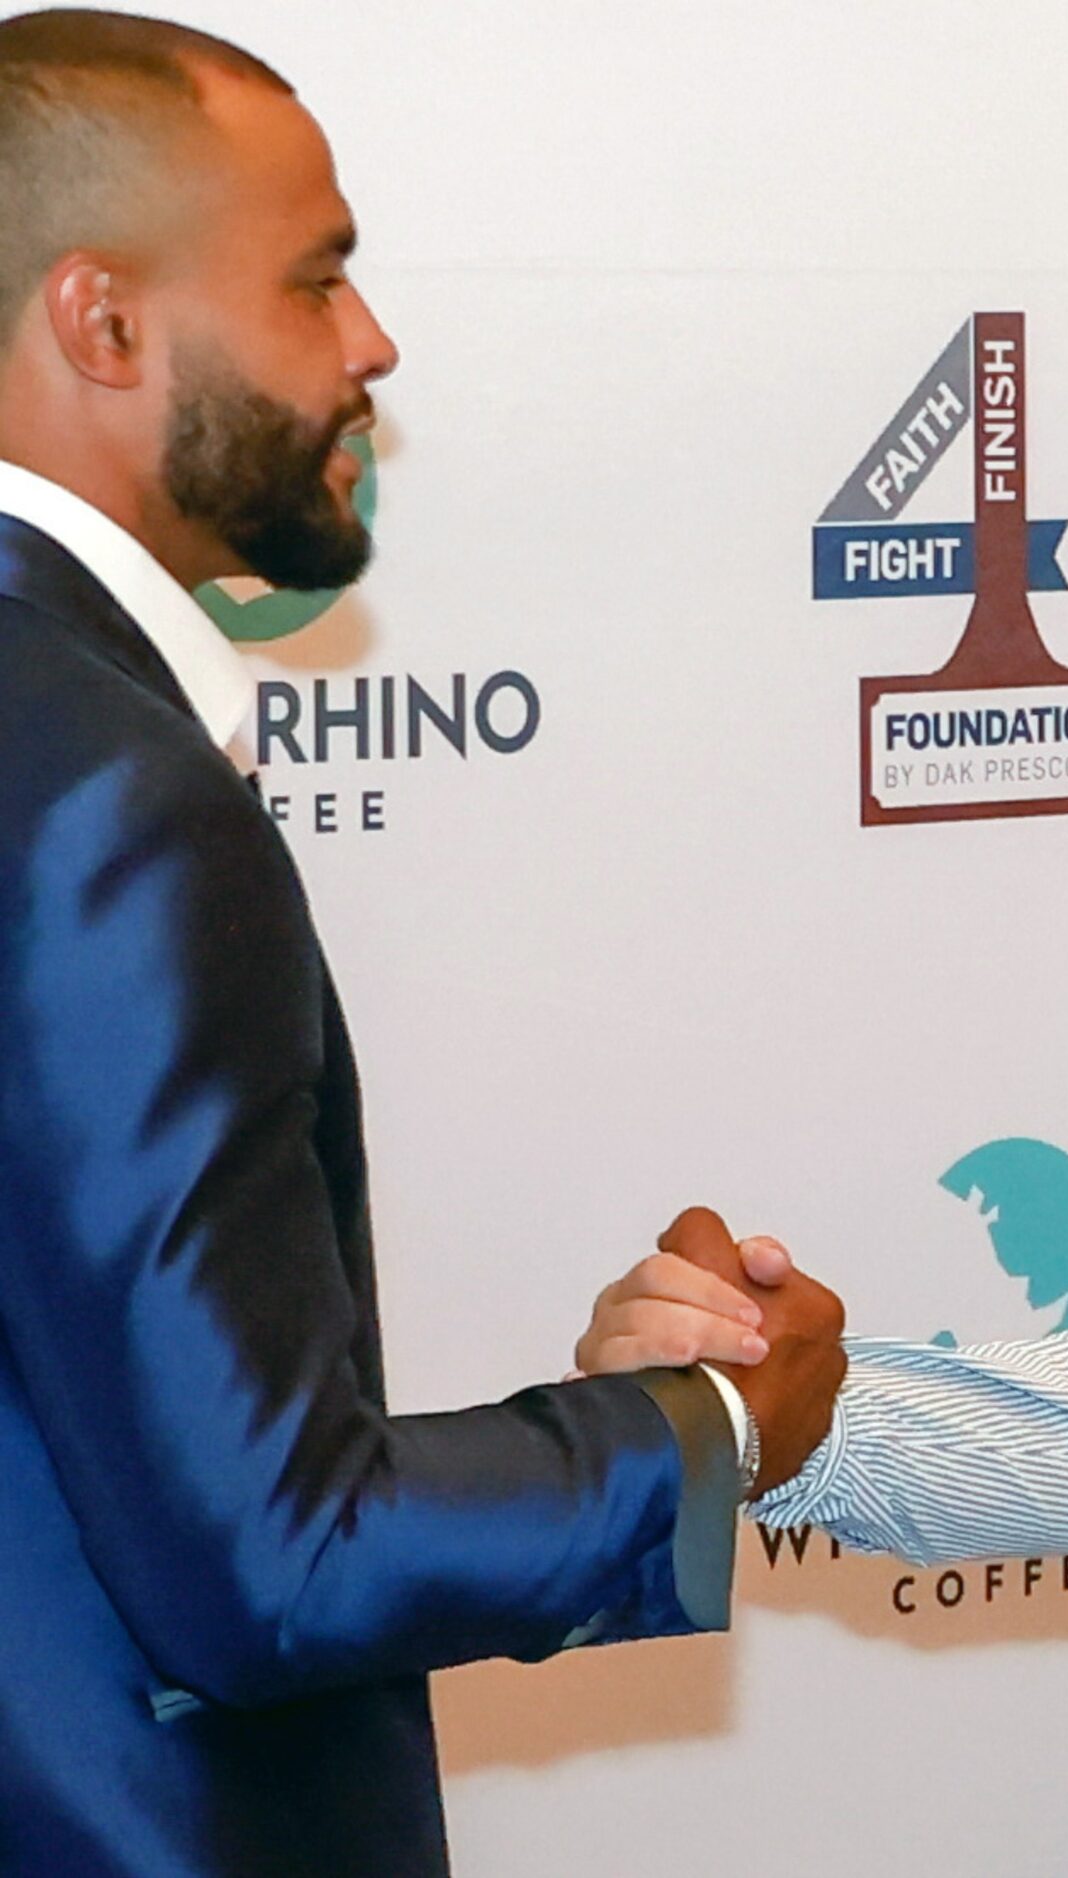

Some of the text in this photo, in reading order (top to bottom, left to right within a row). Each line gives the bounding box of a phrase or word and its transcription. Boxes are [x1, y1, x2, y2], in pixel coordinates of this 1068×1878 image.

[865, 381, 965, 511] FAITH
[983, 340, 1016, 501] FINISH
[845, 537, 962, 582] FIGHT
[256, 669, 541, 766] RHINO
[884, 764, 914, 788] BY
[925, 760, 974, 787] DAK
[269, 790, 386, 834] FEE
